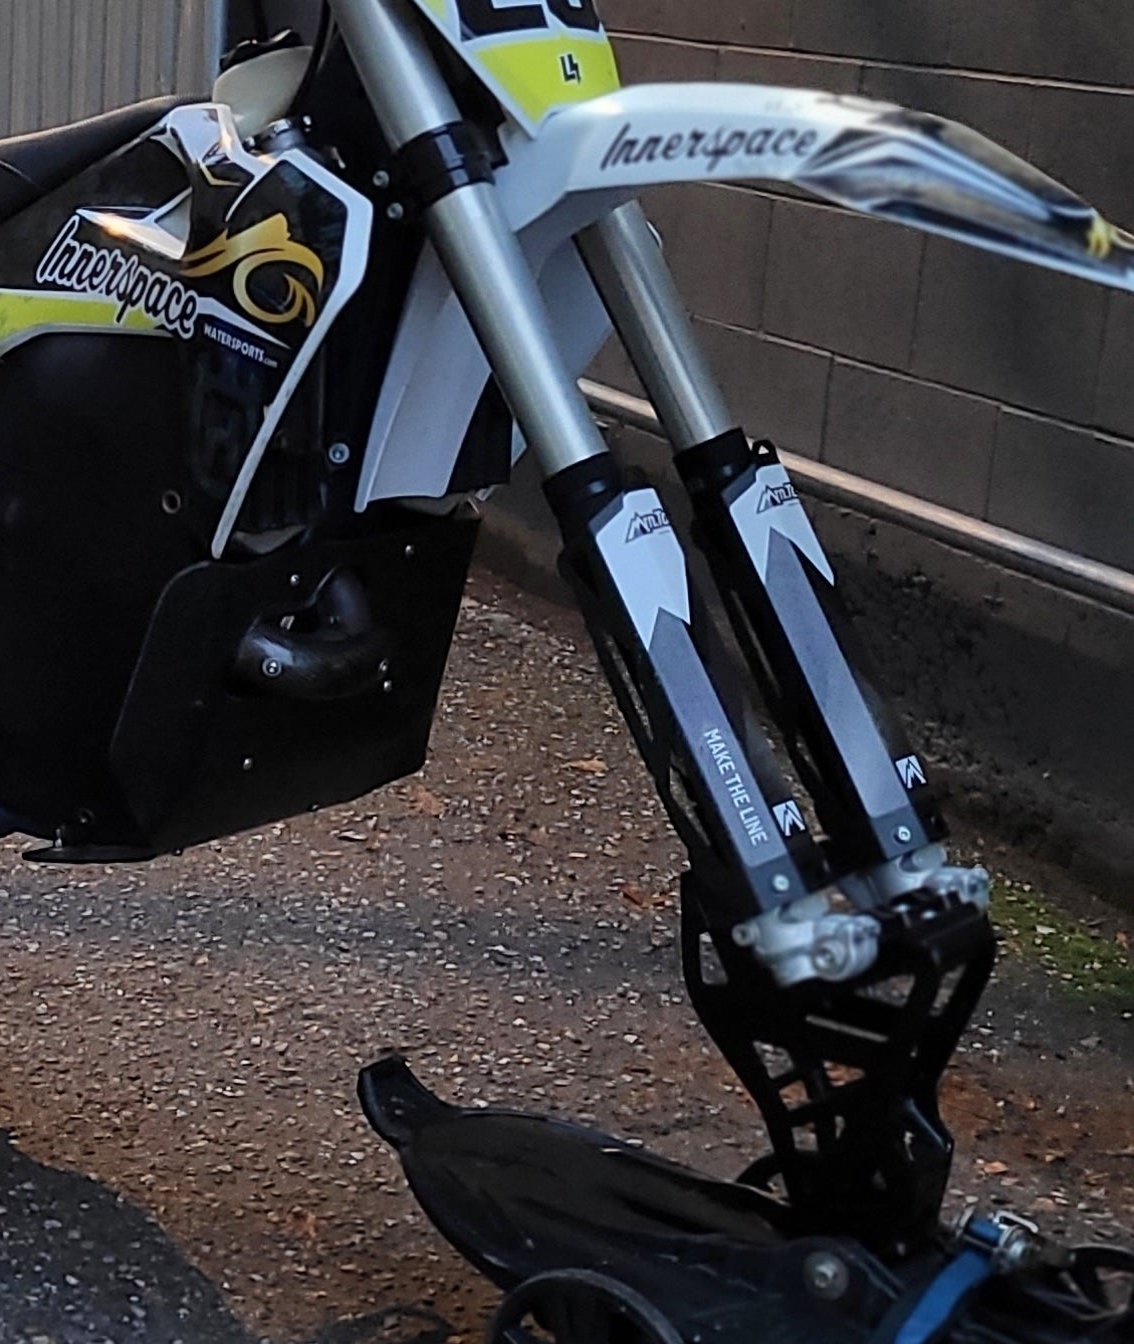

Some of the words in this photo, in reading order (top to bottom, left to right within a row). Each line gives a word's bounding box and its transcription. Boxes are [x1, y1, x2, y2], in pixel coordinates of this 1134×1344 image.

[600, 122, 818, 171] Innerspace
[36, 214, 199, 338] Innerspace
[704, 728, 735, 775] MAKE
[725, 773, 751, 808] THE
[739, 807, 768, 846] LINE
